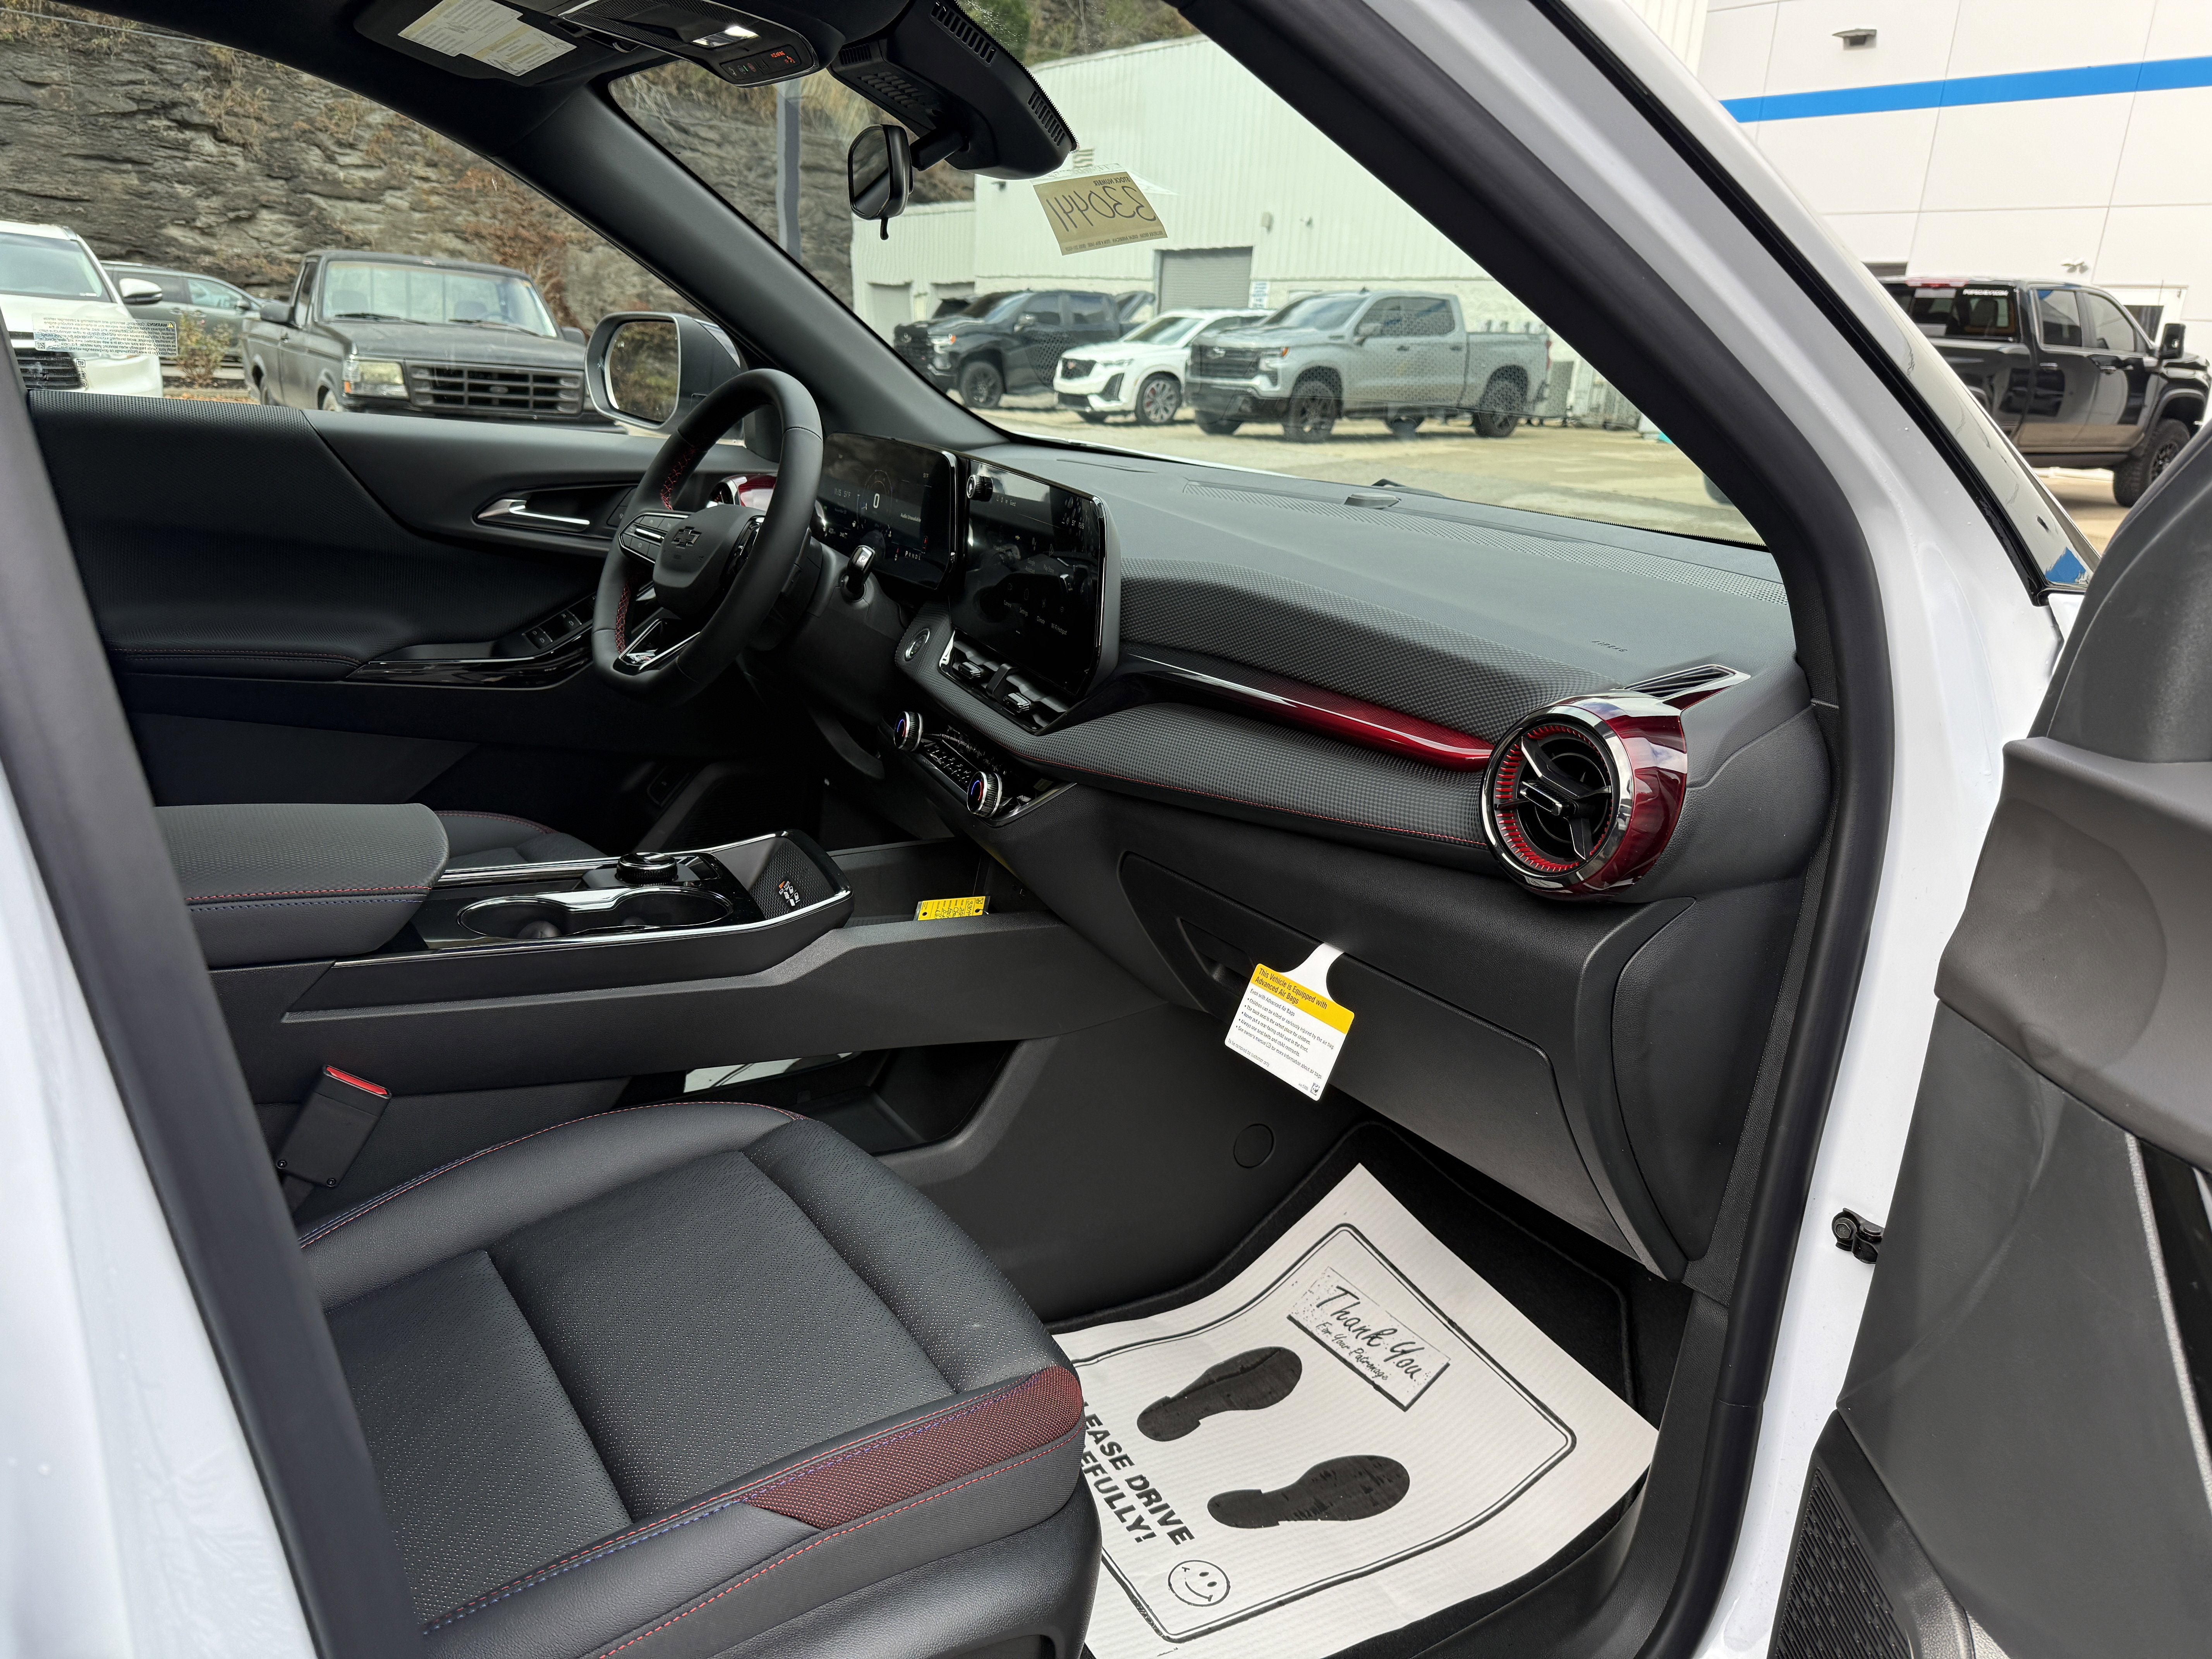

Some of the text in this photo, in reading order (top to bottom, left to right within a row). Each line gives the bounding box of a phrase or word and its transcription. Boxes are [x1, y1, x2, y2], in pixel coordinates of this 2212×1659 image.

[873, 493, 880, 509] 0
[1255, 976, 1299, 1004] Advanced Air Bags
[1259, 967, 1269, 978] This
[1269, 973, 1286, 988] Vehicle
[1292, 986, 1316, 1003] Equipped
[1316, 999, 1327, 1009] with
[1316, 1285, 1425, 1380] Thank You
[1316, 1322, 1389, 1381] For Your Patronage
[1081, 1450, 1157, 1544] EFULLY!
[1084, 1401, 1195, 1546] EASE DRIVE
